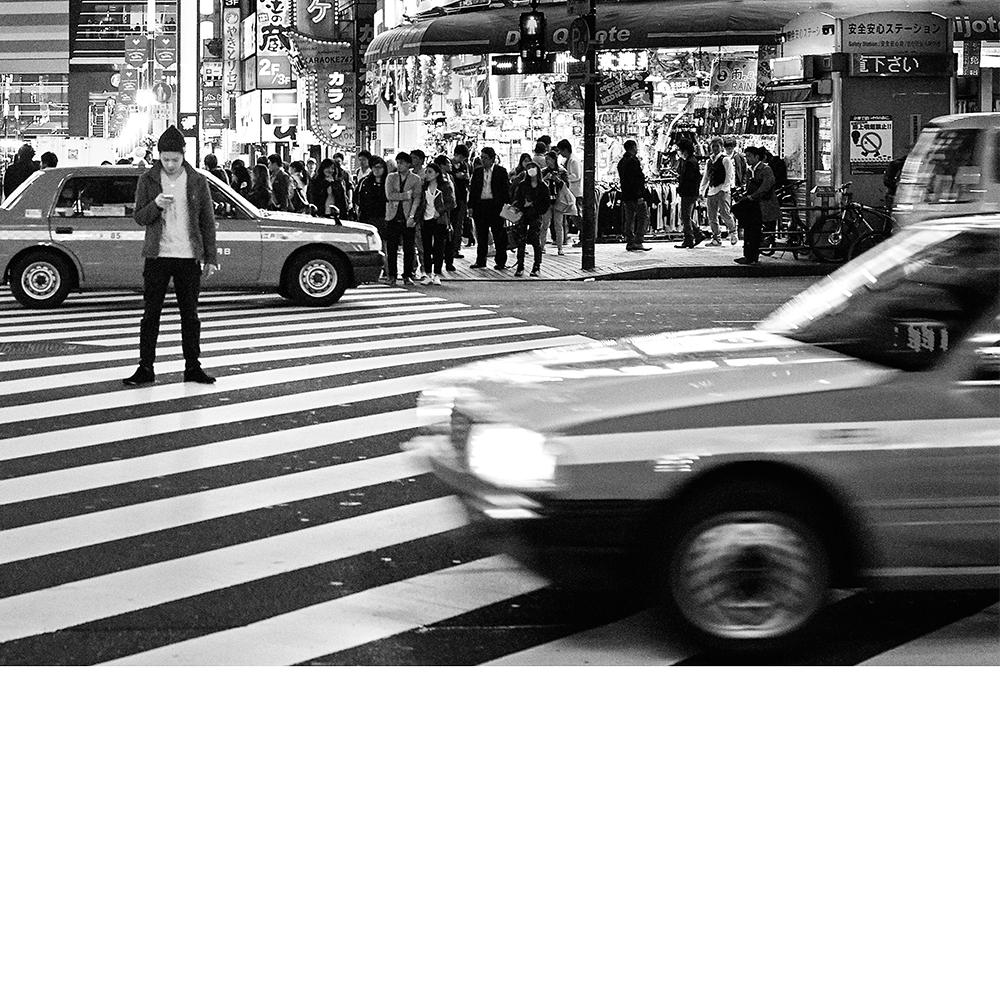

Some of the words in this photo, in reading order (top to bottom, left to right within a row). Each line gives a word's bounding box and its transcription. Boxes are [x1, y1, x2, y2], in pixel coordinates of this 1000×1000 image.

[848, 23, 941, 34] 安全安心ステーション
[953, 16, 1000, 38] ijot
[259, 58, 281, 76] 2F
[731, 82, 753, 91] RAIN
[327, 71, 346, 139] カラオケ
[360, 108, 377, 121] B1
